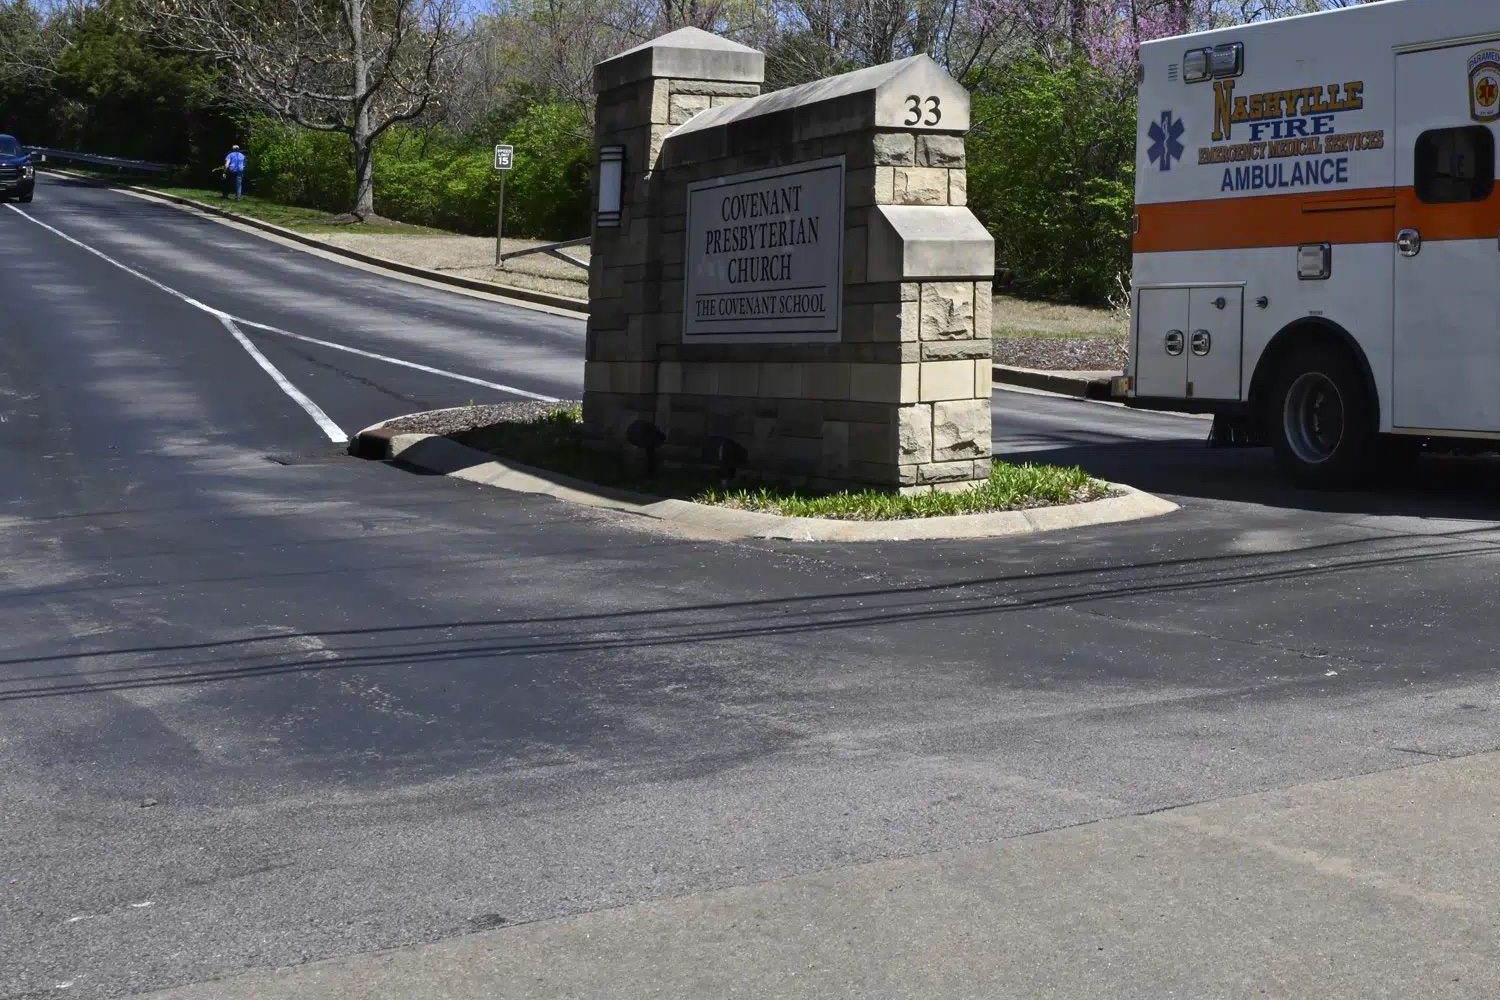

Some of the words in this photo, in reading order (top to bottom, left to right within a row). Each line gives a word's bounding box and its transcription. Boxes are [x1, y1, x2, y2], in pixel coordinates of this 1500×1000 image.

[904, 94, 942, 126] 33
[1212, 80, 1364, 142] NASHVILLE
[1249, 115, 1335, 141] FIRE
[499, 157, 509, 165] 15
[1198, 141, 1267, 165] EMERGENCY
[1267, 136, 1322, 159] MEDICAL
[1325, 130, 1384, 153] SERVICES
[1221, 158, 1348, 192] AMBULANCE
[721, 185, 802, 222] COVENANT
[705, 216, 820, 255] PRESBYTERIAN
[727, 254, 792, 284] CHURCH
[696, 299, 716, 317] THE
[718, 295, 777, 316] COVENANT
[779, 293, 826, 314] SCHOOL
